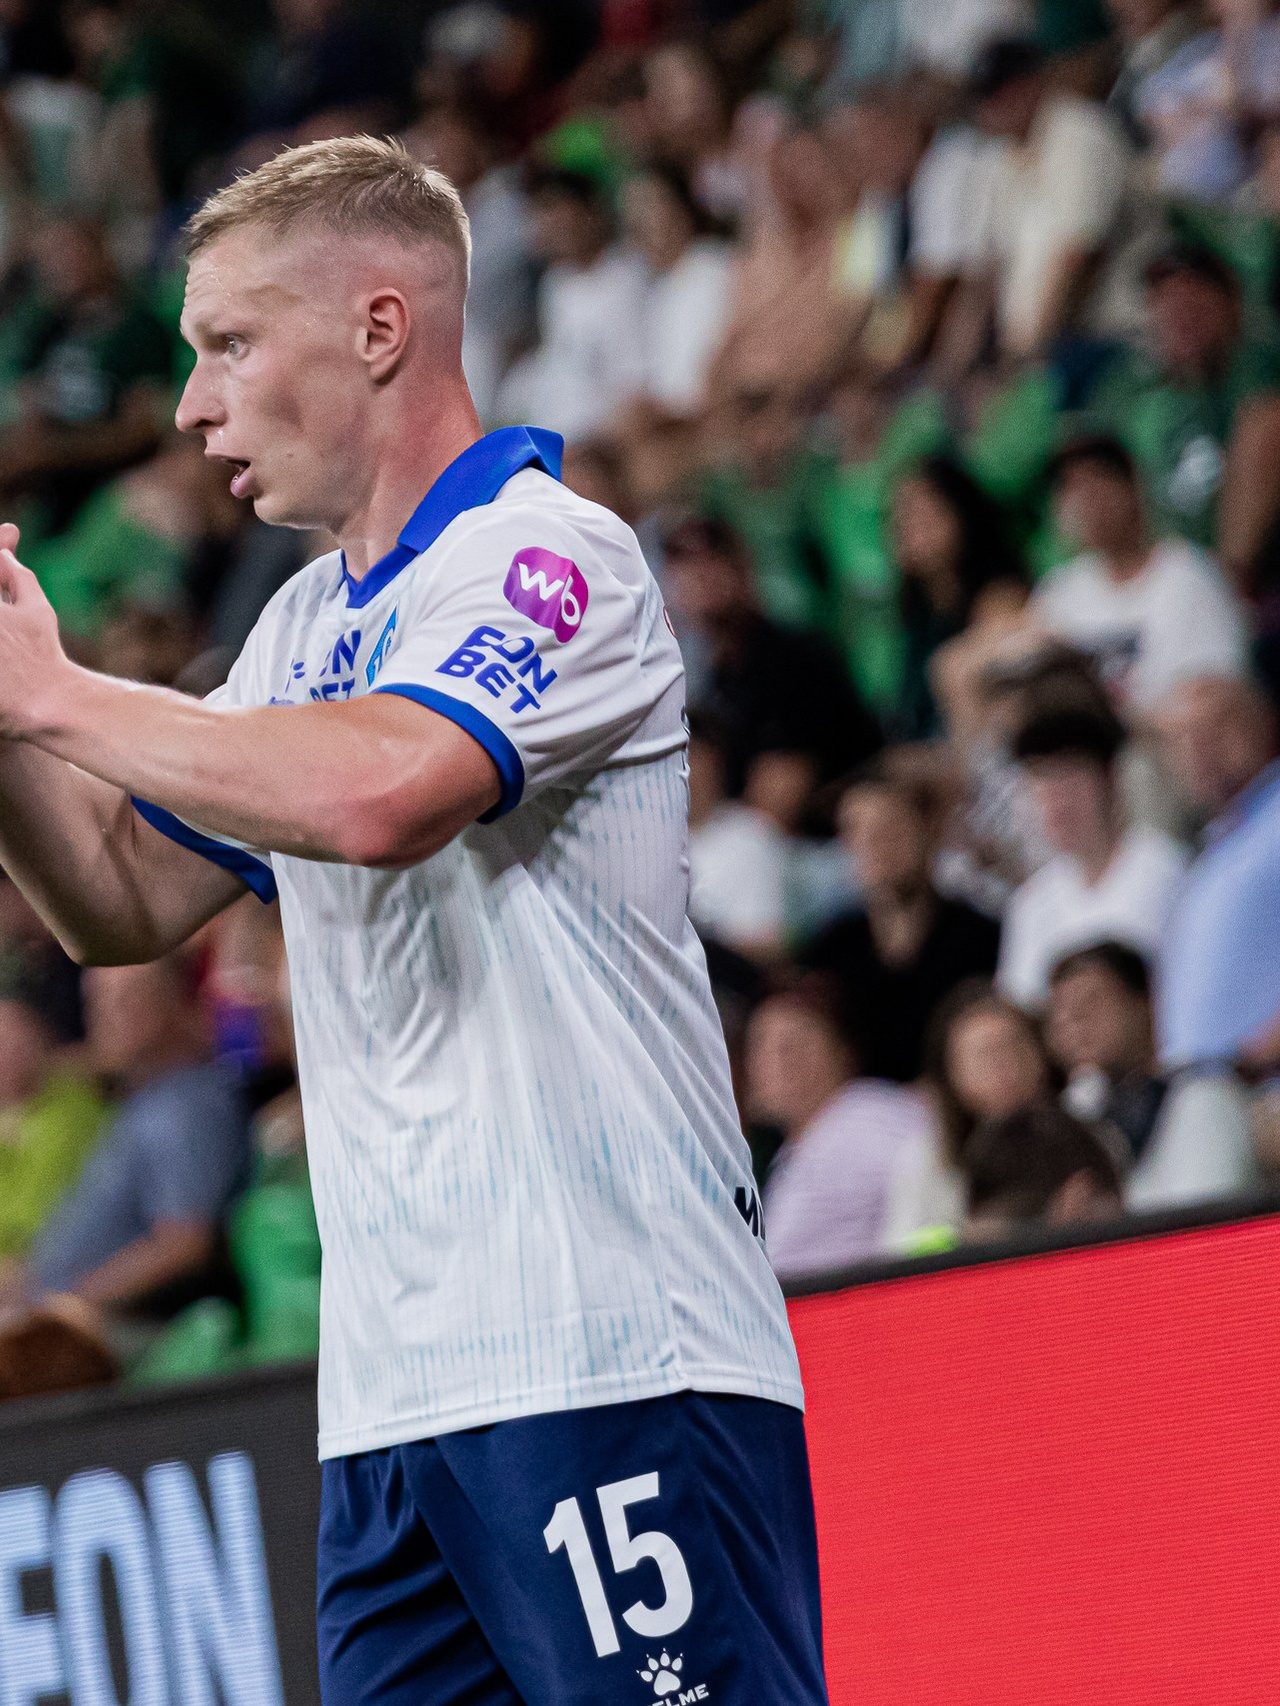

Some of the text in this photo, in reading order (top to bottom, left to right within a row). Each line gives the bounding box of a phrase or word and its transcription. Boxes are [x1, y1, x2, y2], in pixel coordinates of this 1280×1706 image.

[434, 647, 542, 715] BET
[463, 625, 558, 695] FON
[543, 1471, 693, 1658] 15
